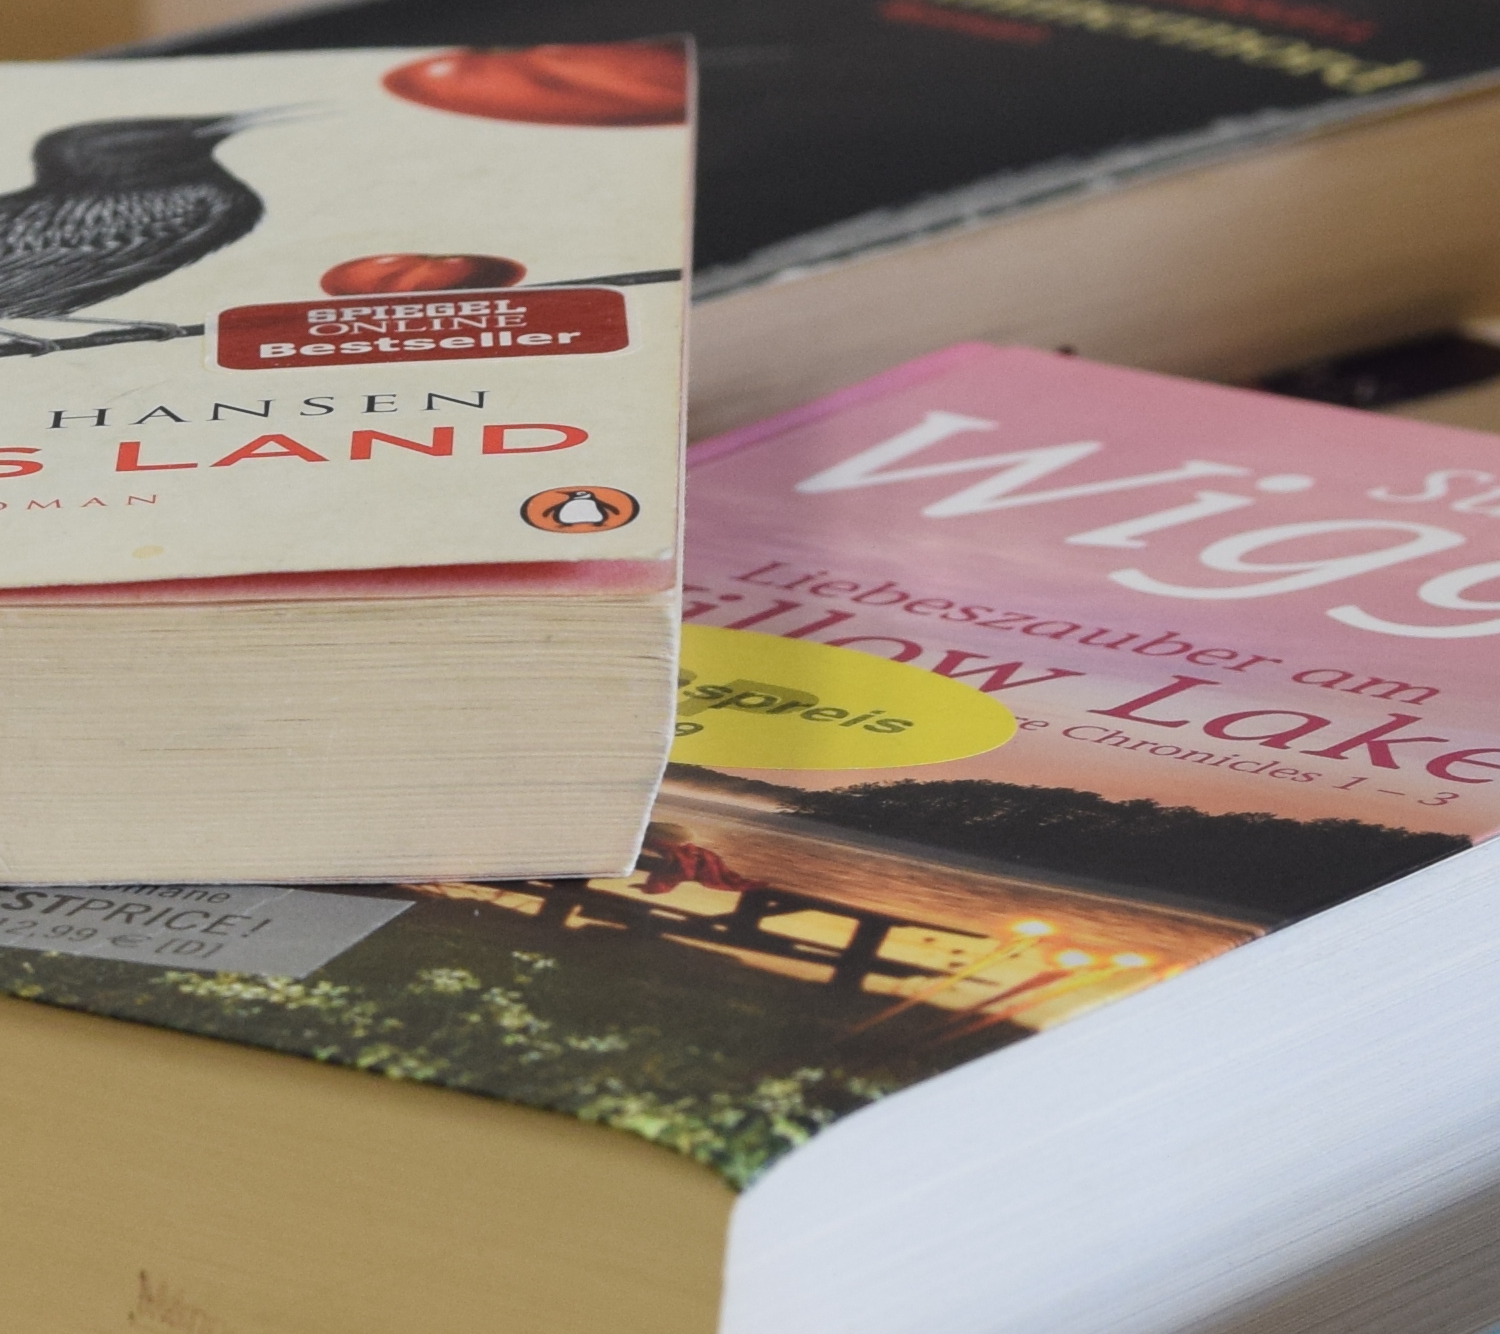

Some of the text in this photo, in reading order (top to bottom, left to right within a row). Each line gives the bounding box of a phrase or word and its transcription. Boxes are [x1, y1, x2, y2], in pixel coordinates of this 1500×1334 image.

[307, 299, 527, 324] SPIEGEL
[308, 314, 527, 337] ONLINE
[259, 330, 581, 359] Bestseller
[47, 389, 493, 431] HANSEN
[114, 421, 590, 474] LAND
[682, 585, 1066, 694] illow
[739, 559, 1443, 707] Liebeszauber am
[683, 682, 914, 734] spreis
[1058, 721, 1323, 788] Chronicles
[1420, 788, 1456, 809] 3
[100, 884, 230, 905] omane
[109, 933, 152, 948] €
